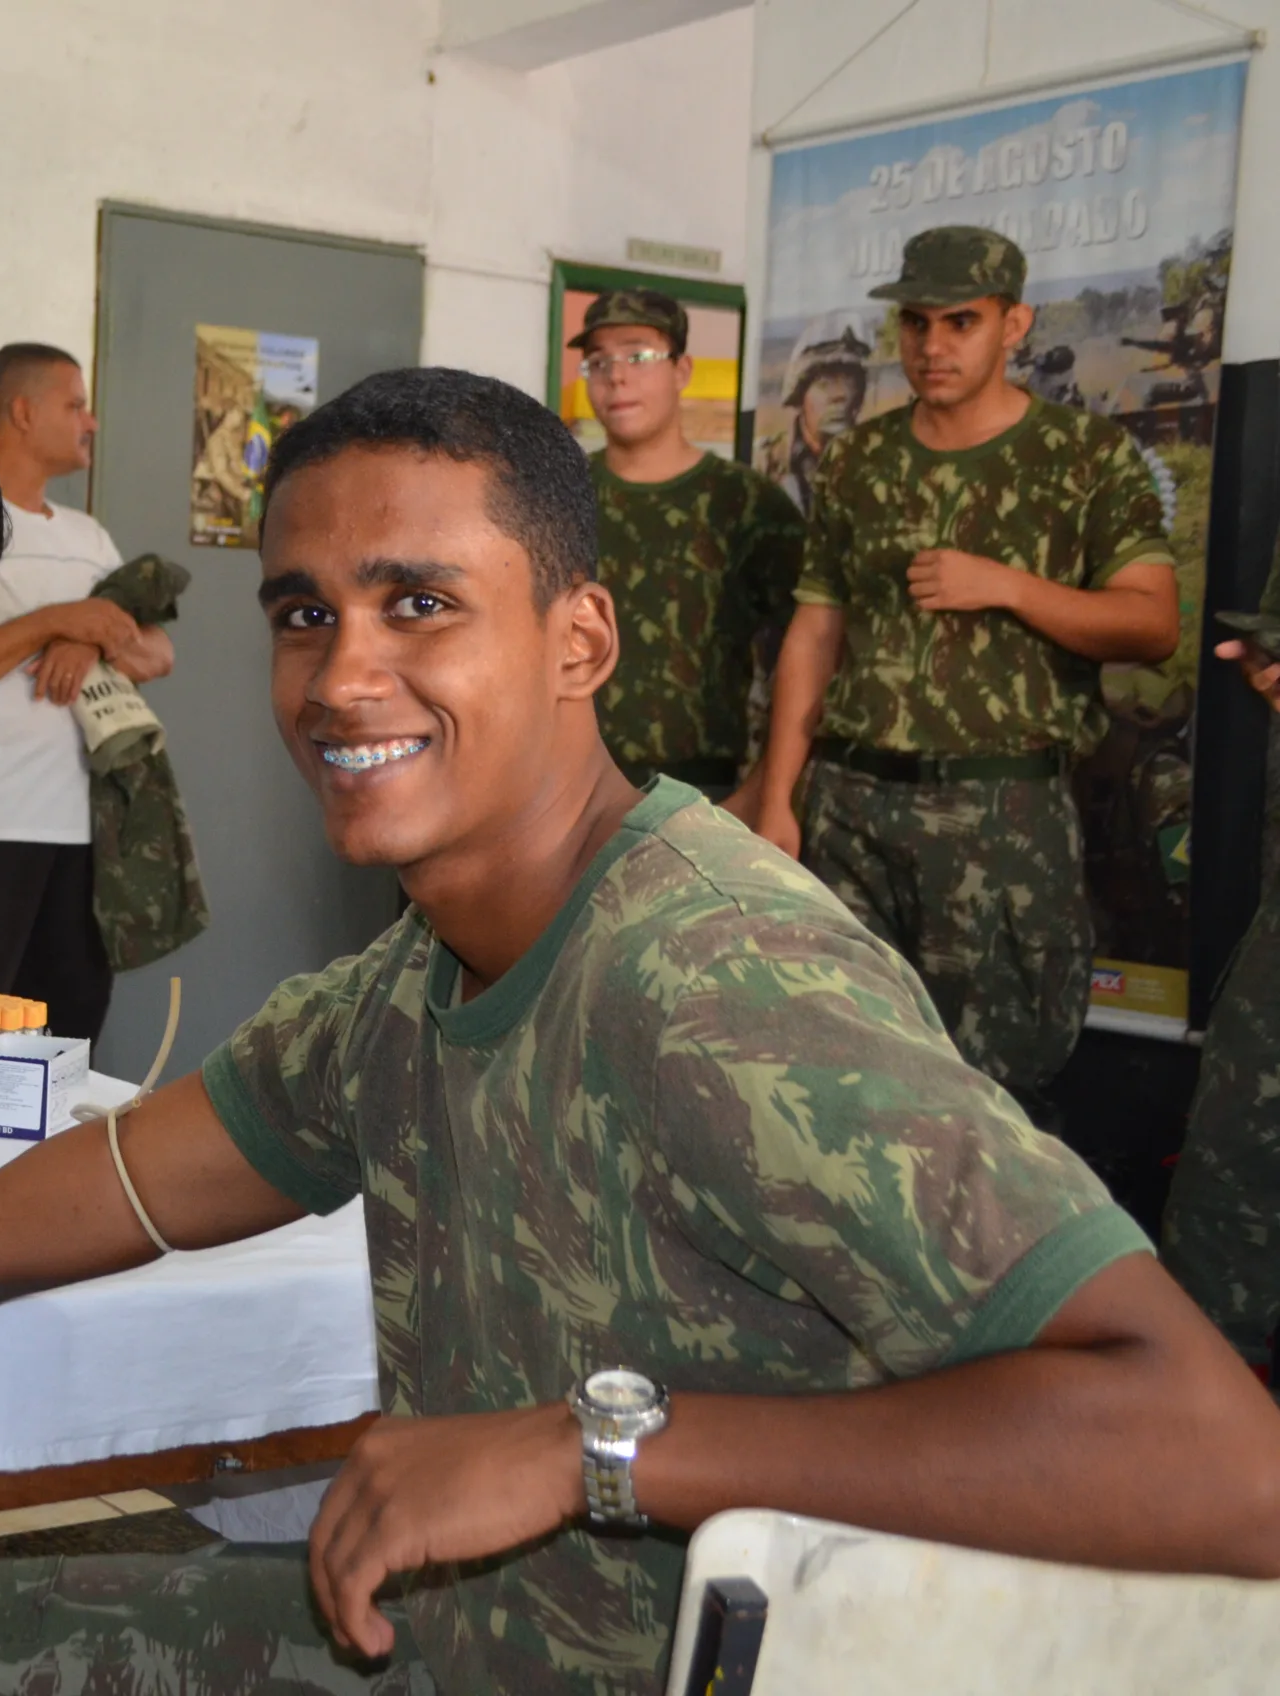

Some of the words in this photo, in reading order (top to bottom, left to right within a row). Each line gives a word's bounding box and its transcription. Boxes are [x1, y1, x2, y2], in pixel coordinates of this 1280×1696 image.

[868, 161, 914, 214] 25
[921, 150, 965, 204] DE
[972, 121, 1128, 195] AGOSTO
[850, 227, 902, 278] DIA
[980, 186, 1149, 254] OLDADO
[1091, 971, 1122, 990] PEX
[2, 1126, 13, 1134] BD
